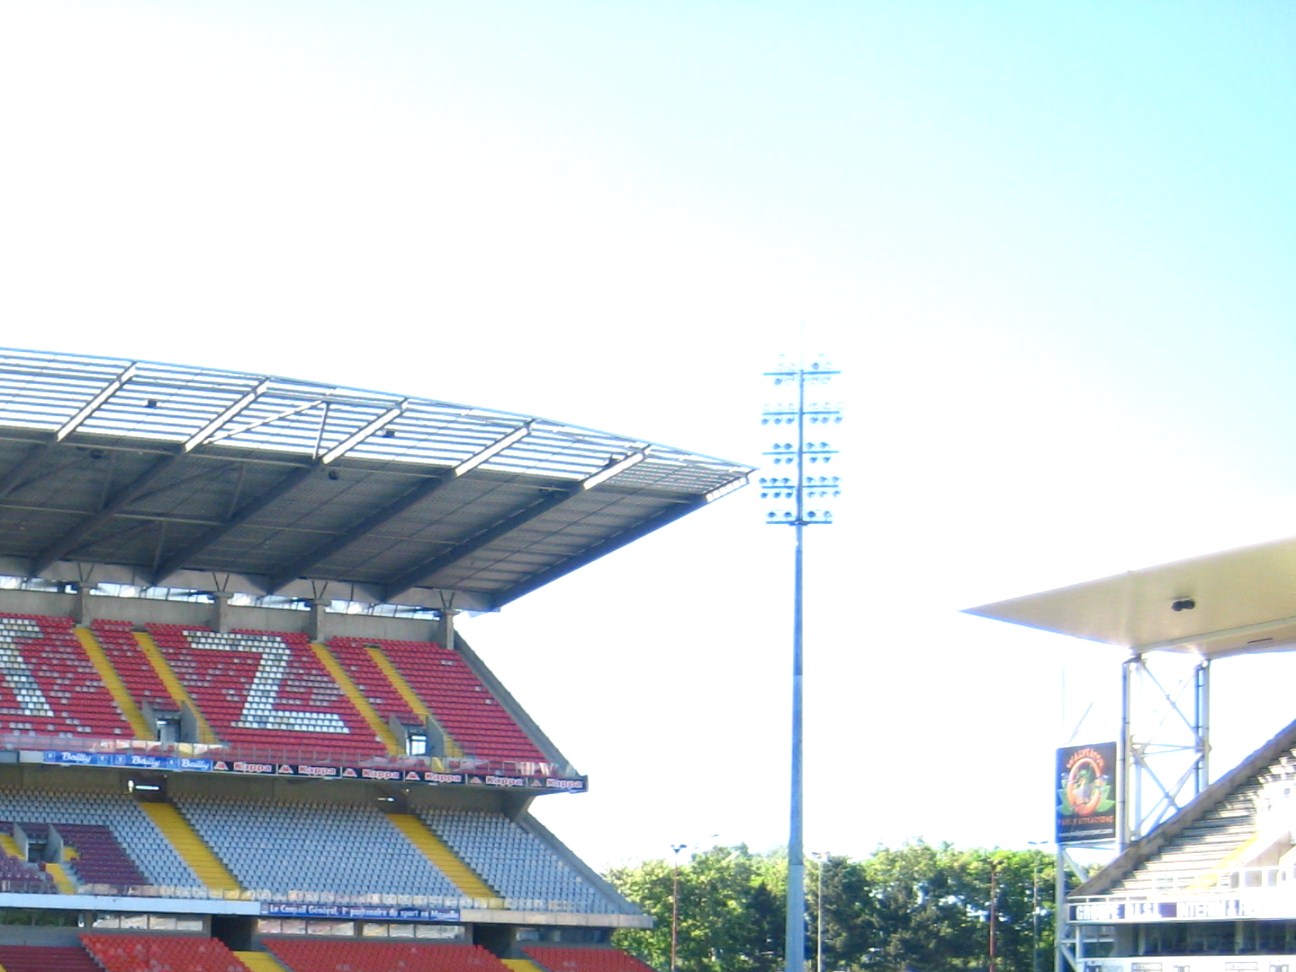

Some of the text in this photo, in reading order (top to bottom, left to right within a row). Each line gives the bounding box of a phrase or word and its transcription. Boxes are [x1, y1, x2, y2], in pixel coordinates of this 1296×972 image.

[233, 762, 272, 774] Kappa
[298, 765, 337, 777] Kappa
[362, 768, 401, 779] Kappa
[424, 773, 462, 784] Kappa
[486, 776, 523, 787] Kappa
[546, 779, 584, 789] Kappa
